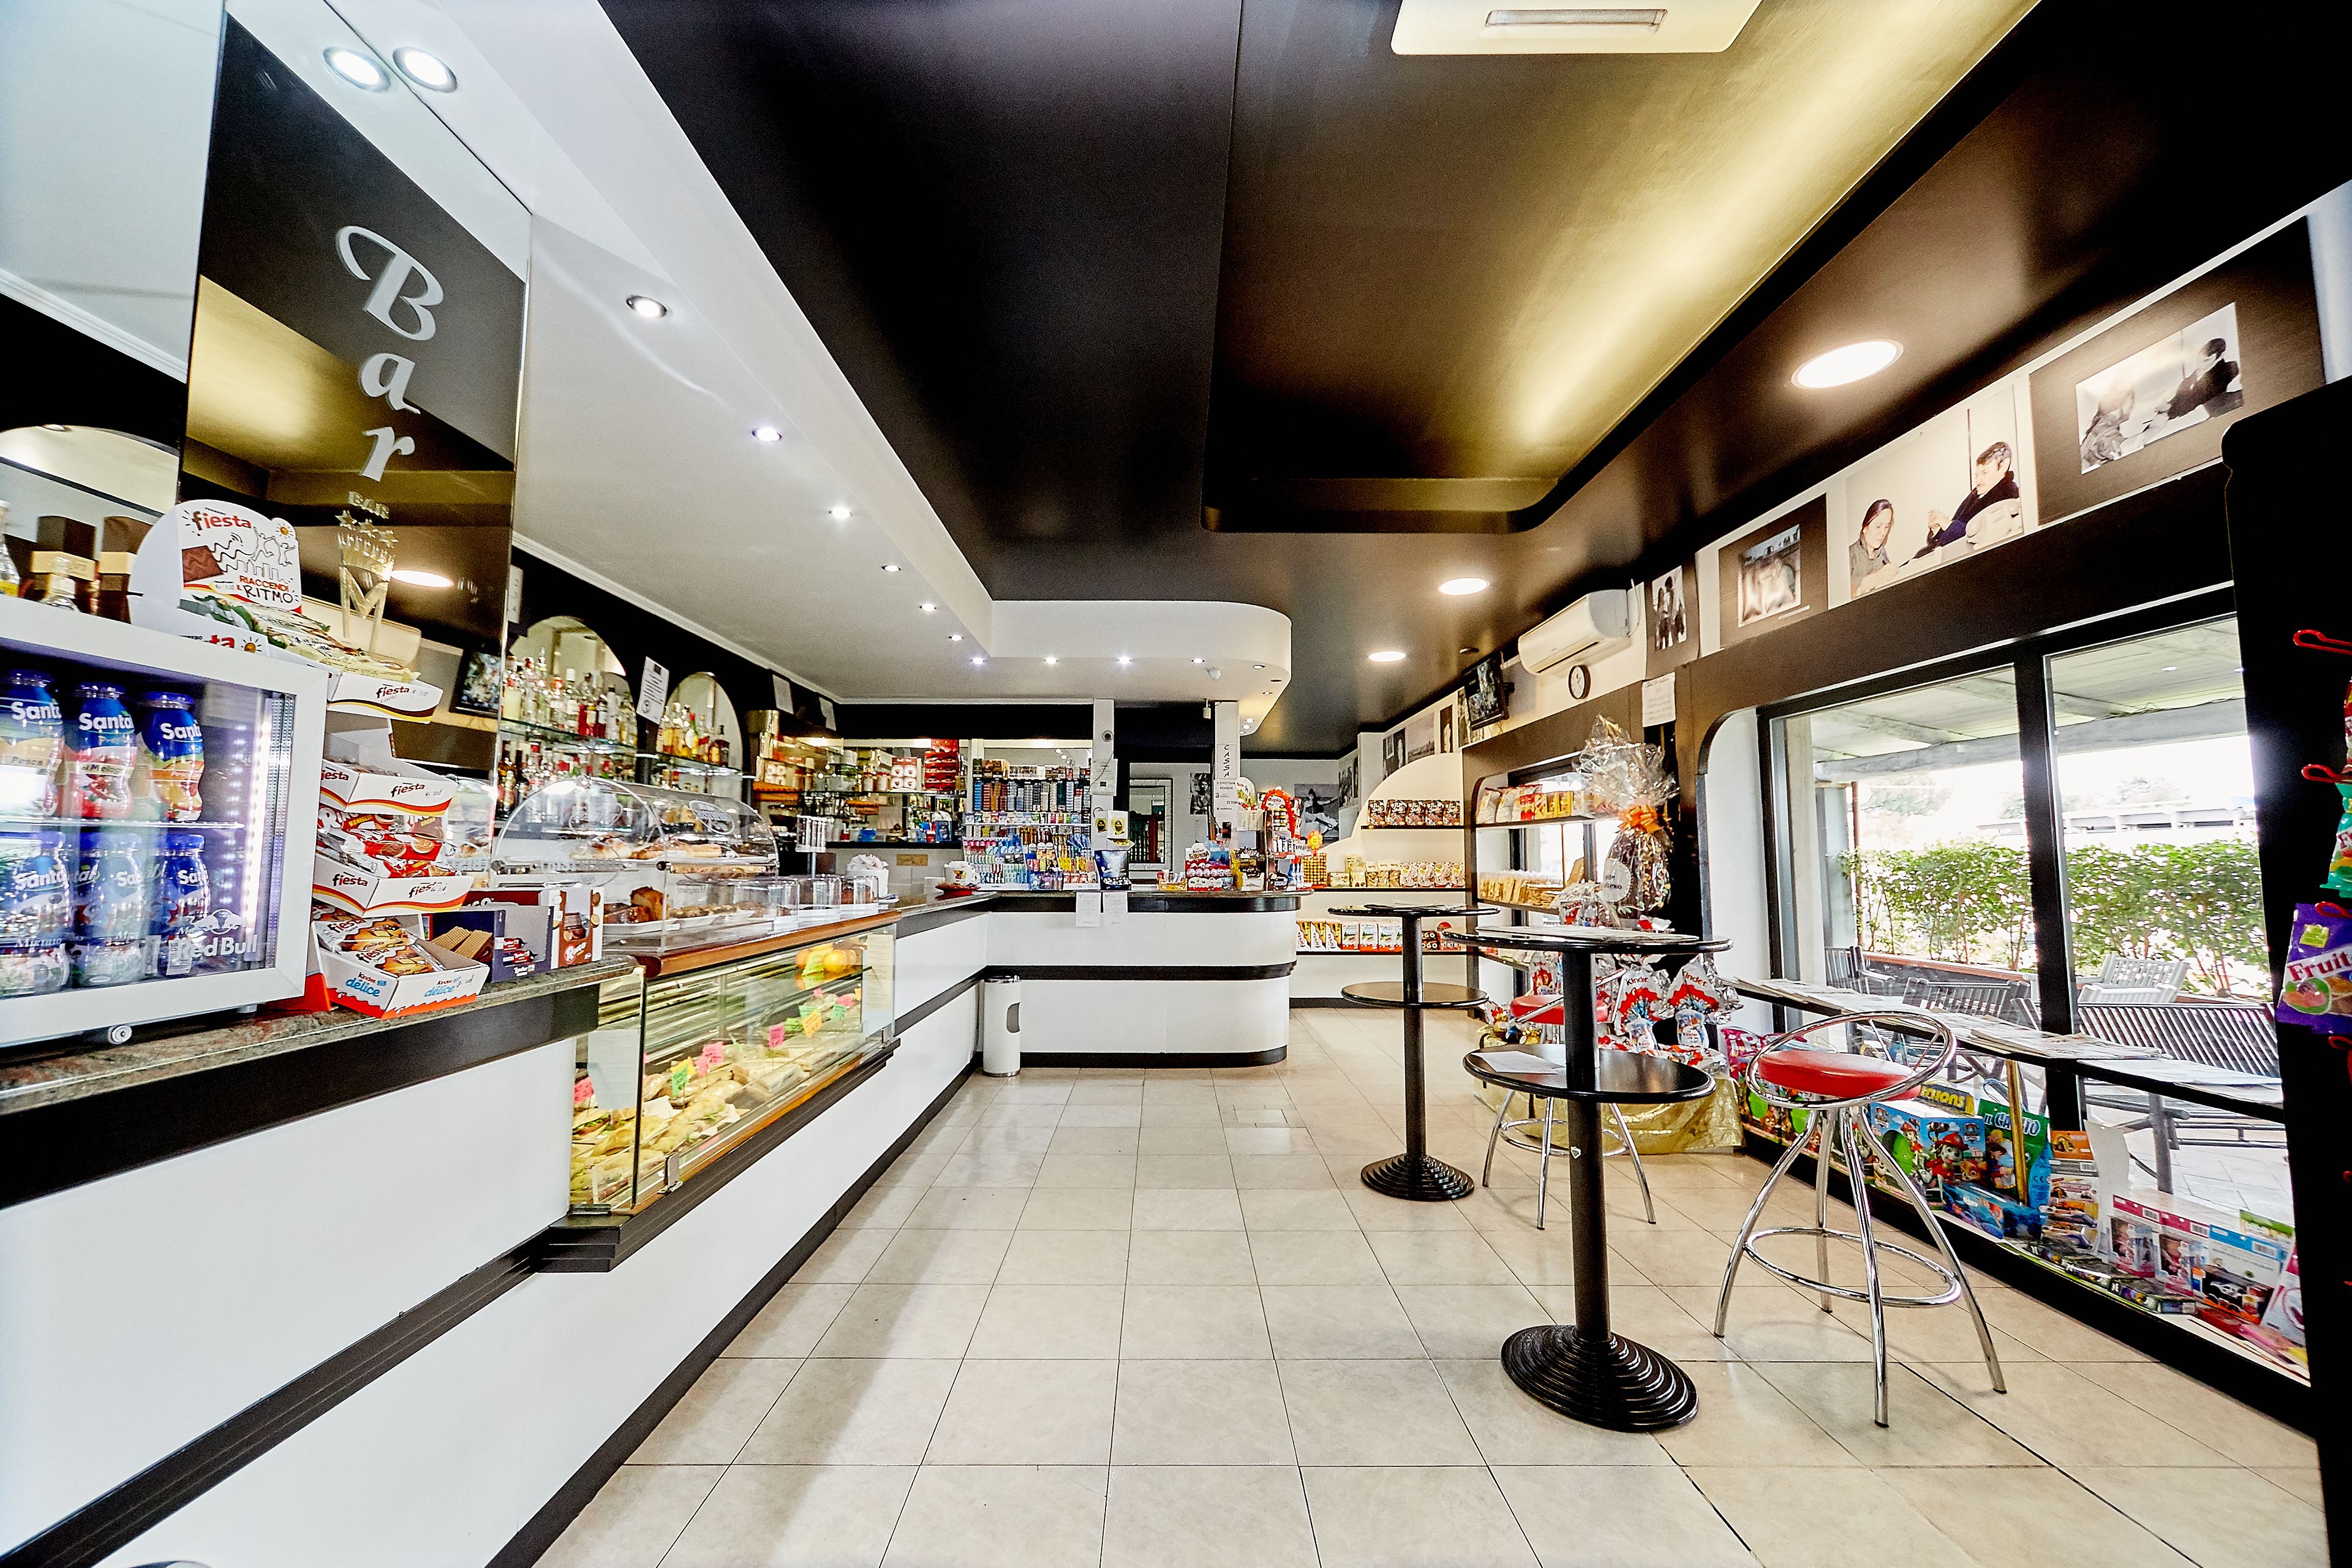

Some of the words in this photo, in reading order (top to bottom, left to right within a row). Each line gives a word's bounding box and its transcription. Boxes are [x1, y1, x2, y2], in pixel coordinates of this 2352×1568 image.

[336, 225, 445, 482] Bar
[192, 511, 252, 530] fiesta
[239, 575, 289, 592] RIACCENDI
[243, 585, 293, 603] RITMO
[376, 686, 410, 698] fiesta
[321, 769, 349, 781] iesta
[391, 783, 426, 797] fiesta
[332, 873, 368, 887] fiesta
[326, 918, 367, 934] fiesta
[177, 937, 216, 959] Red
[221, 934, 257, 955] Bull
[355, 948, 390, 963] fiesta
[2286, 951, 2351, 982] Fruit
[358, 971, 377, 984] Kinder
[1627, 976, 1648, 986] Kinder
[345, 978, 380, 997] délice
[424, 985, 455, 997] délice
[1984, 1113, 1992, 1125] IL
[1994, 1112, 2040, 1136] CAIO
